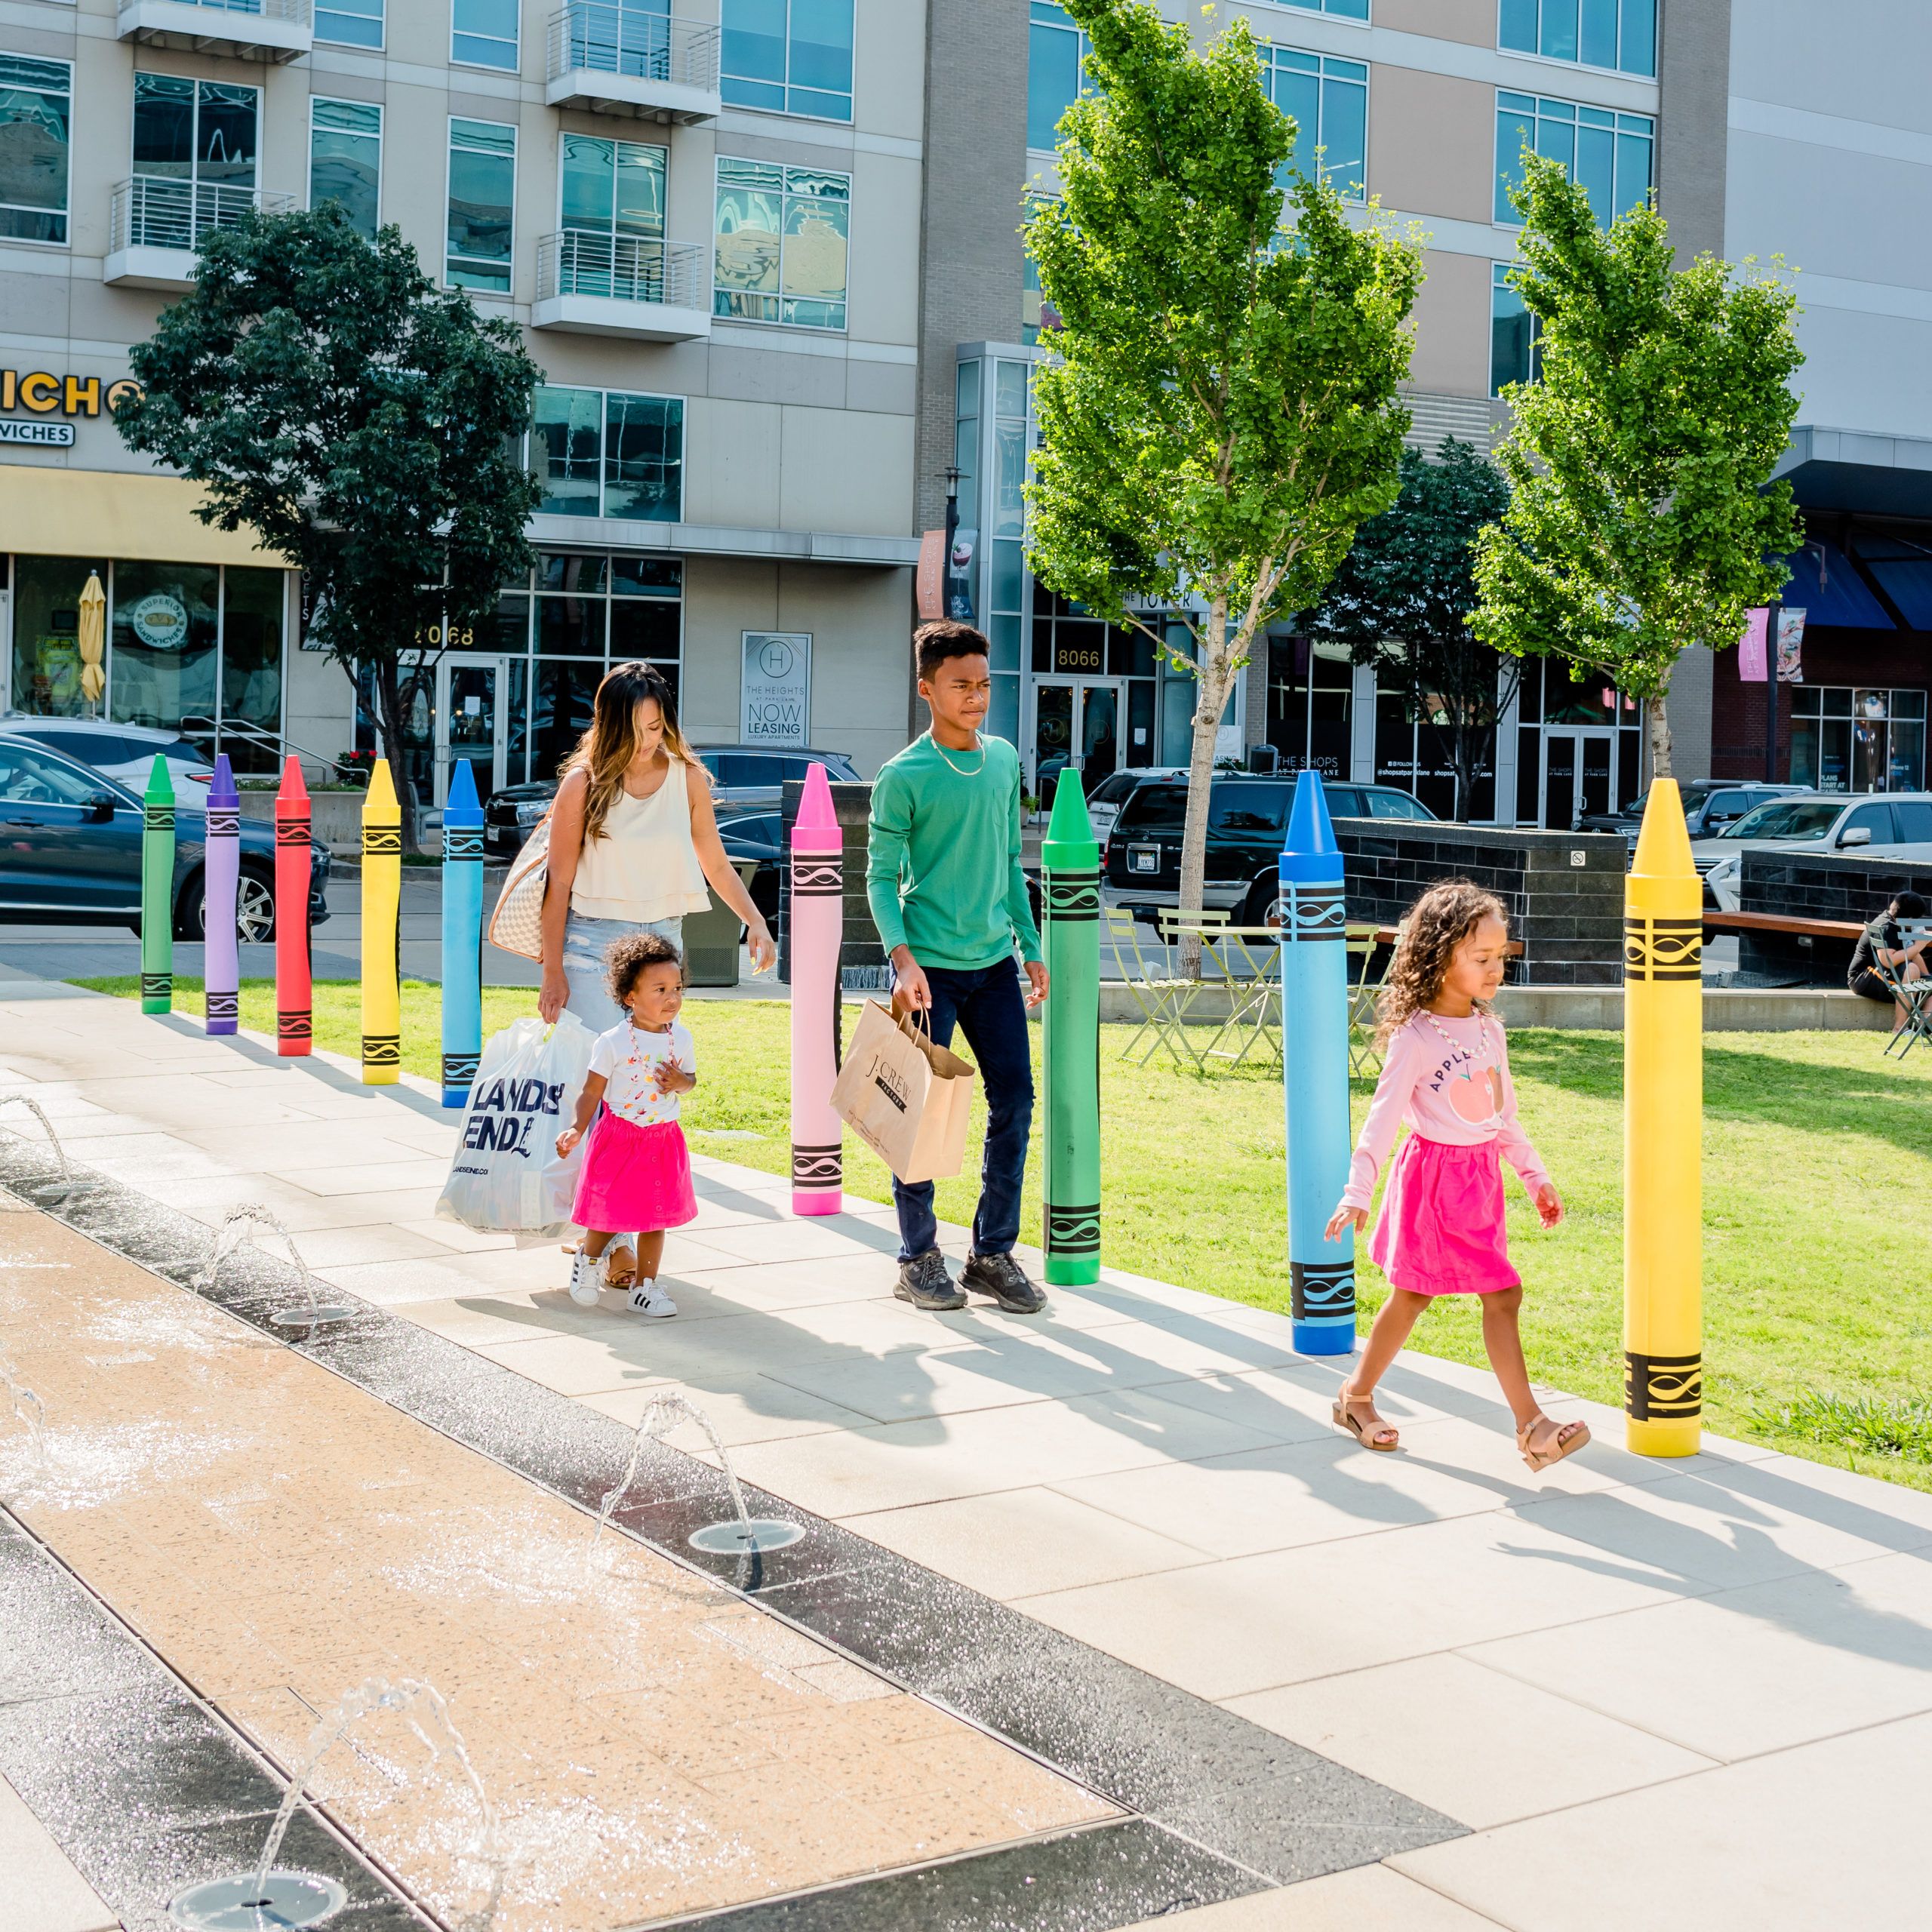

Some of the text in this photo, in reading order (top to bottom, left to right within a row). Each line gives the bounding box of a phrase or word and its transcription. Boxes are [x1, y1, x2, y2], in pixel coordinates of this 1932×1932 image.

[0, 370, 100, 417] ICH
[1124, 591, 1135, 601] HE
[141, 598, 183, 617] SUPERIOR
[137, 621, 183, 644] SANDWICHES
[1058, 650, 1099, 666] 8066
[746, 685, 804, 695] THE HEIGHTS
[749, 703, 801, 722] NOW
[748, 722, 801, 734] LEASING
[1278, 755, 1338, 768] THE SHOPS
[1429, 1051, 1471, 1093] APPLE
[881, 1081, 903, 1107] FACTORY
